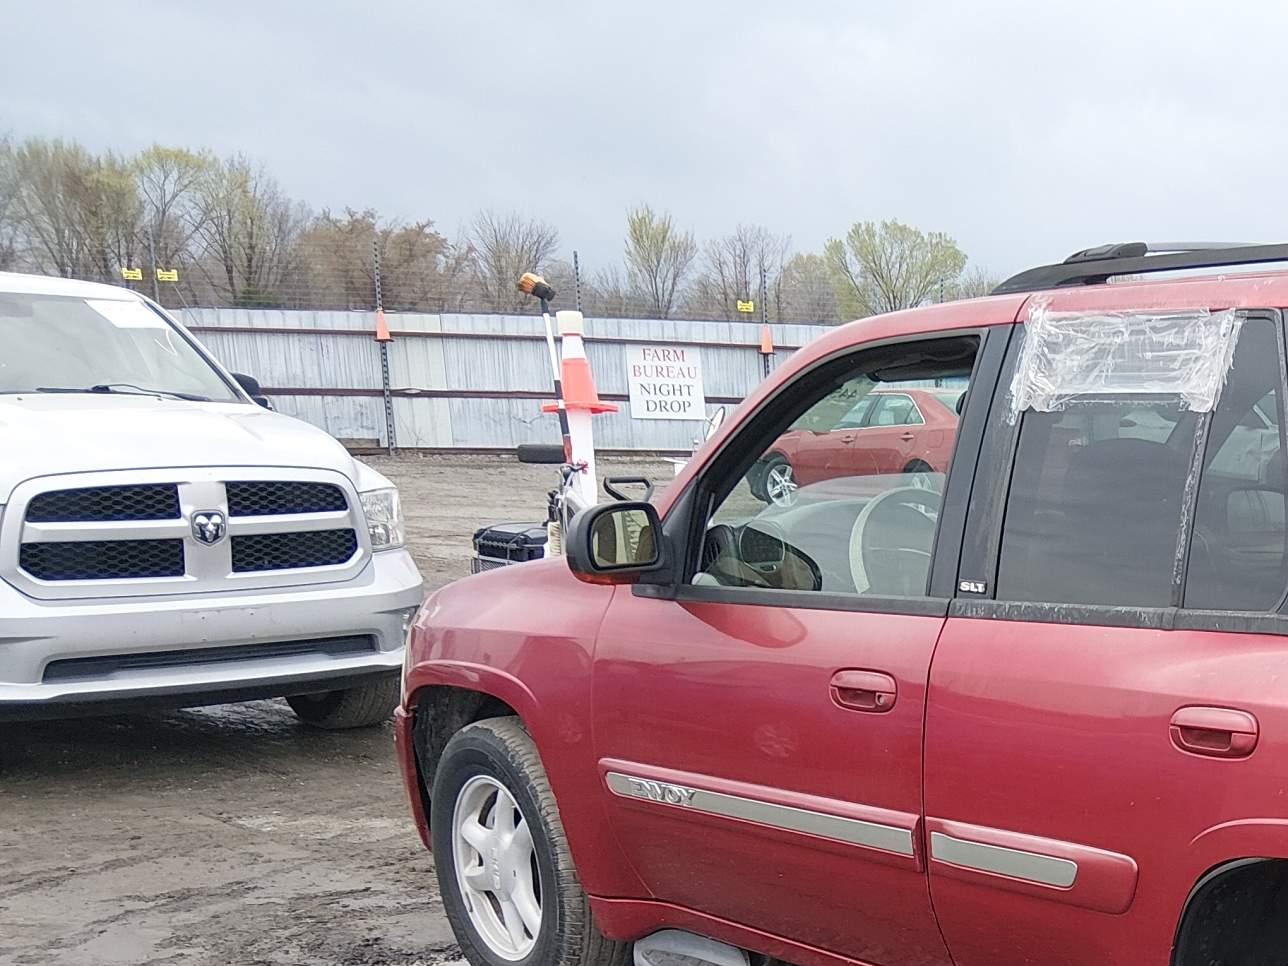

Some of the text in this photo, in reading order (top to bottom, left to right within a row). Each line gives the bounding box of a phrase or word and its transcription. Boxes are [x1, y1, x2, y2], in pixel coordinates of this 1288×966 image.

[642, 348, 686, 362] FARM
[633, 365, 697, 379] BUREAU
[639, 383, 695, 397] NIGHT
[646, 399, 692, 413] DROP
[960, 581, 986, 593] SLT
[628, 778, 697, 806] ENVOY
